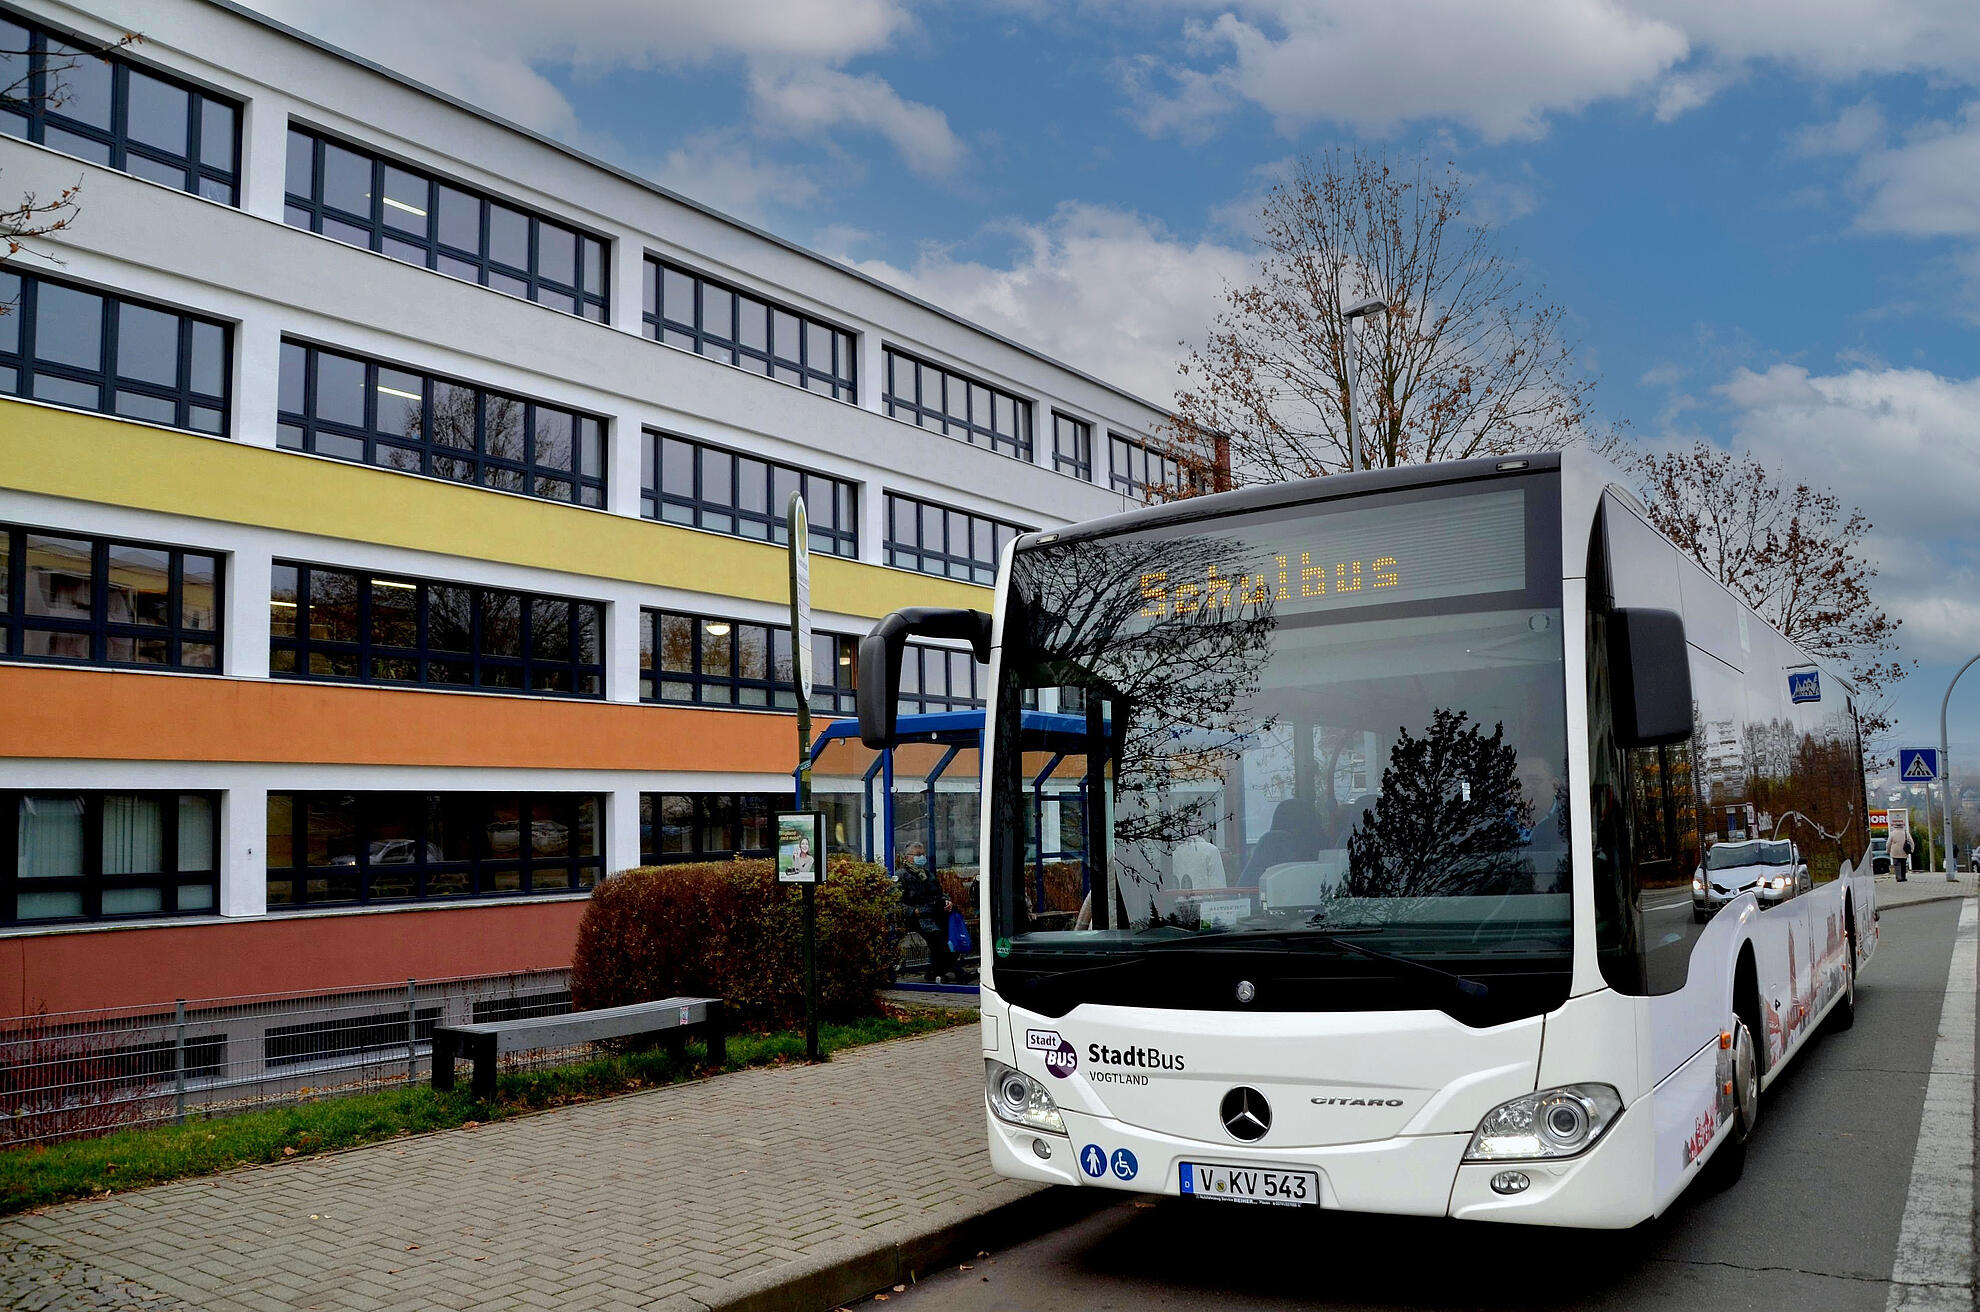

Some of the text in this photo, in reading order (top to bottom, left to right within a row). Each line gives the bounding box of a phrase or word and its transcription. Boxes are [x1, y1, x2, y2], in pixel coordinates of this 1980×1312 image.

[1141, 552, 1398, 617] Schulbus
[1030, 1034, 1057, 1047] Stadt
[1047, 1051, 1076, 1068] BUS
[1088, 1043, 1185, 1071] StadtBus
[1089, 1071, 1149, 1086] VOGTLAND
[1310, 1096, 1404, 1107] CITARO
[1200, 1168, 1306, 1199] V KV 543
